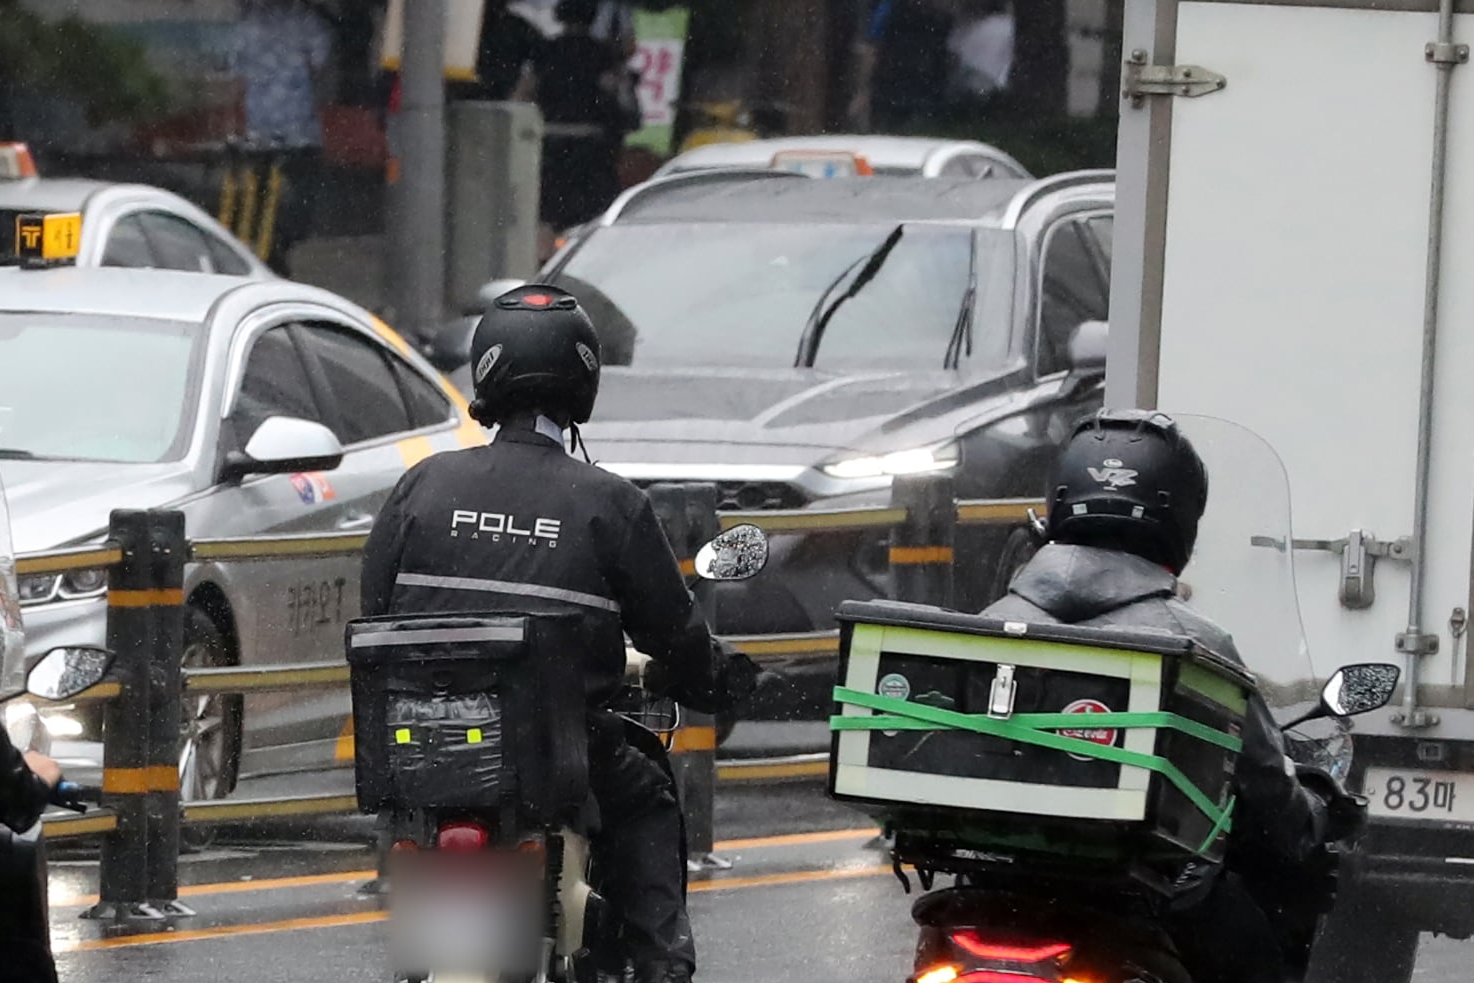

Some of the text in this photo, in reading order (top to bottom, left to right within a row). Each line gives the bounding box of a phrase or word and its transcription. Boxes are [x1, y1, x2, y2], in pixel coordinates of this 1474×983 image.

[451, 509, 562, 539] POLE
[450, 530, 557, 549] RACING
[1383, 775, 1456, 813] 83마
